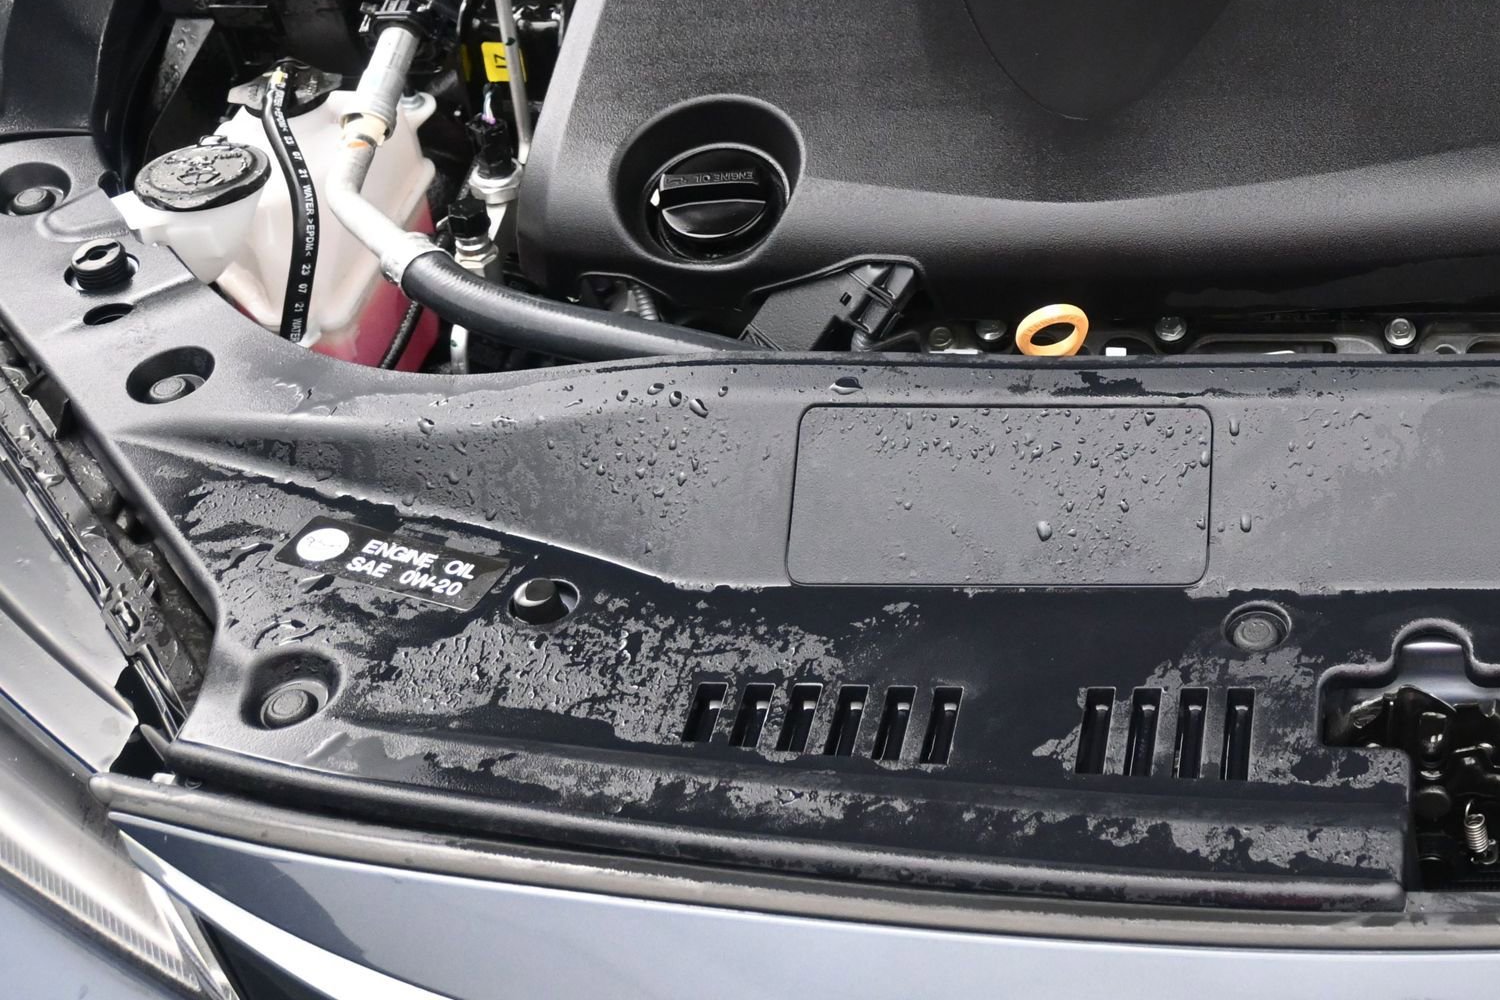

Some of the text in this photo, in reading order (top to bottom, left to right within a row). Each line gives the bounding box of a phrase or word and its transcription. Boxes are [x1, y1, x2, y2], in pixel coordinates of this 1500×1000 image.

[298, 168, 309, 178] 21
[696, 171, 753, 183] ENGINE OIL
[302, 184, 315, 215] WATER
[301, 263, 311, 276] 23
[298, 283, 308, 294] 07
[294, 302, 305, 312] 21
[290, 318, 302, 343] WATER
[361, 539, 475, 580] ENGINE OIL
[346, 557, 463, 597] SAE 0W-20
